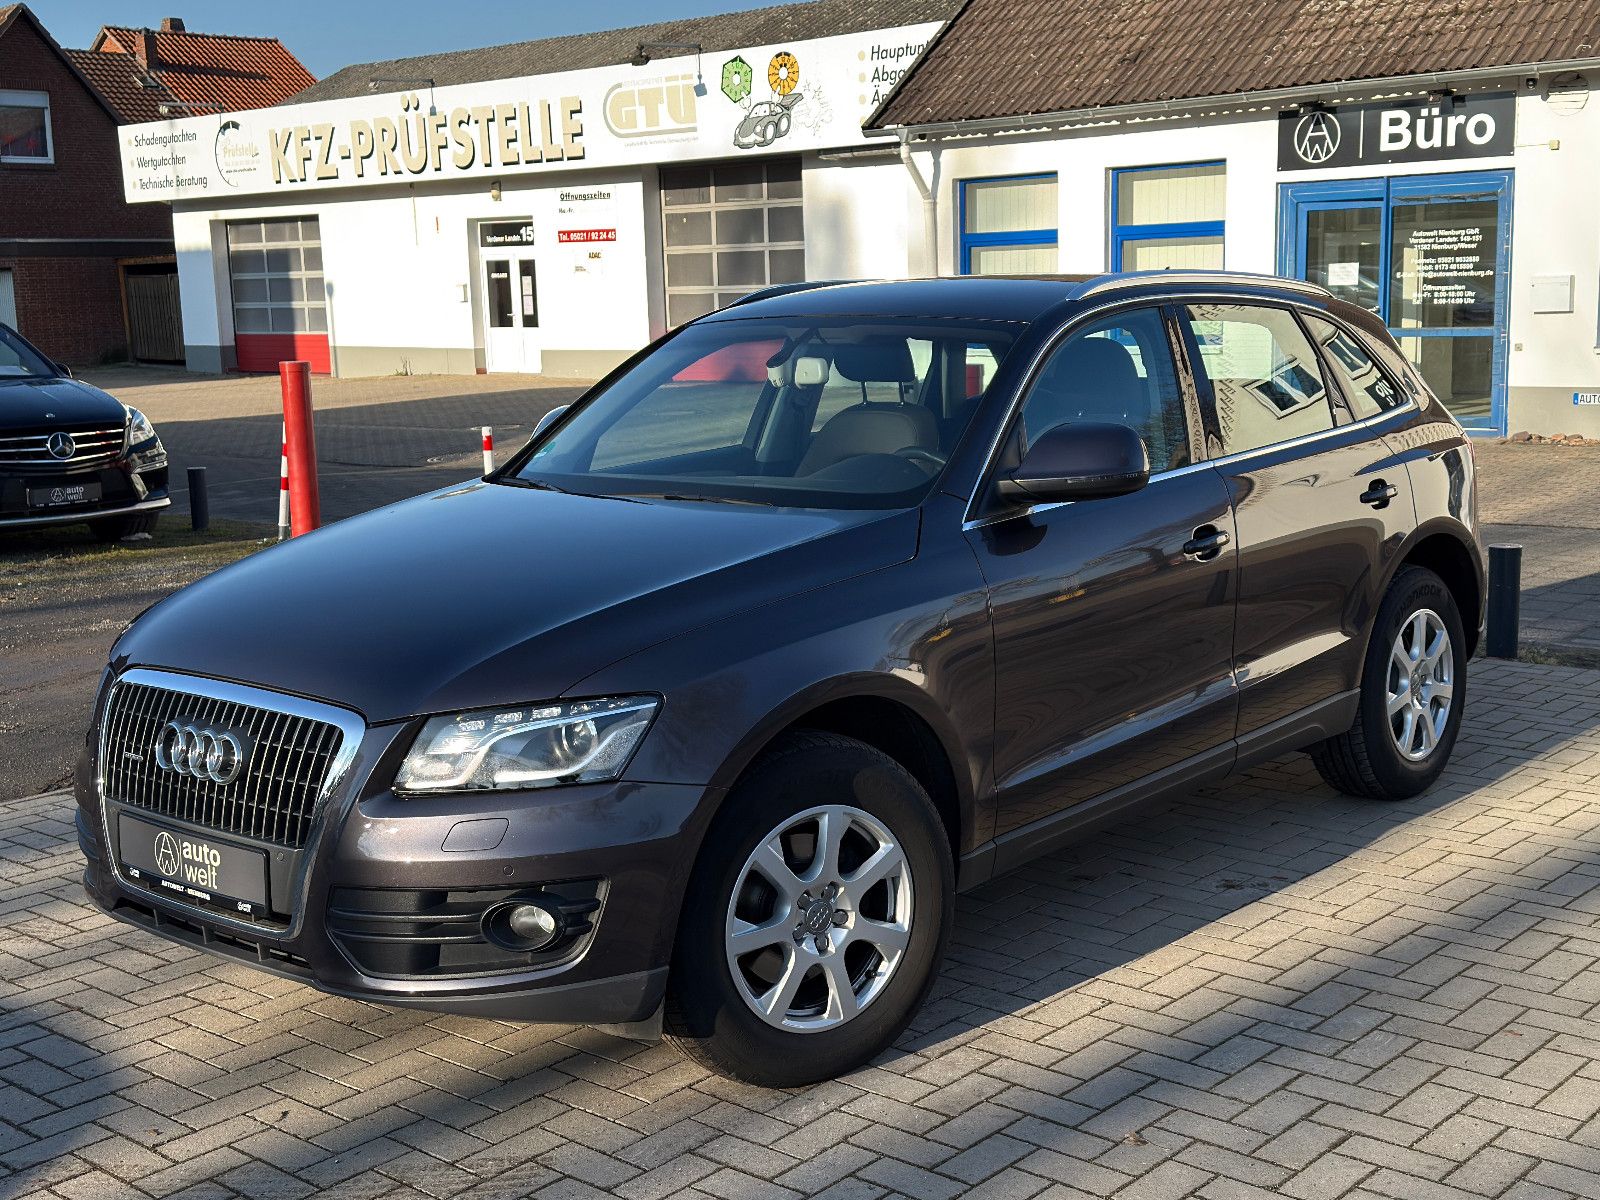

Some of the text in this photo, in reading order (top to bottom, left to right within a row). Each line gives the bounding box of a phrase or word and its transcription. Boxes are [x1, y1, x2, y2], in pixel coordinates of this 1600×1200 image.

[609, 73, 697, 129] GTÜ
[134, 129, 197, 147] Schadengutachten
[268, 93, 585, 184] KFZ-PRÜFSTELLE
[1380, 107, 1496, 152] Büro
[137, 152, 186, 170] Wertgutachten
[139, 175, 208, 189] Technische Beratung
[560, 190, 611, 201] Öffnungszeiten
[599, 231, 606, 240] 24
[608, 231, 616, 239] 45
[66, 486, 84, 494] auto
[182, 840, 221, 866] auto
[184, 863, 218, 889] welt
